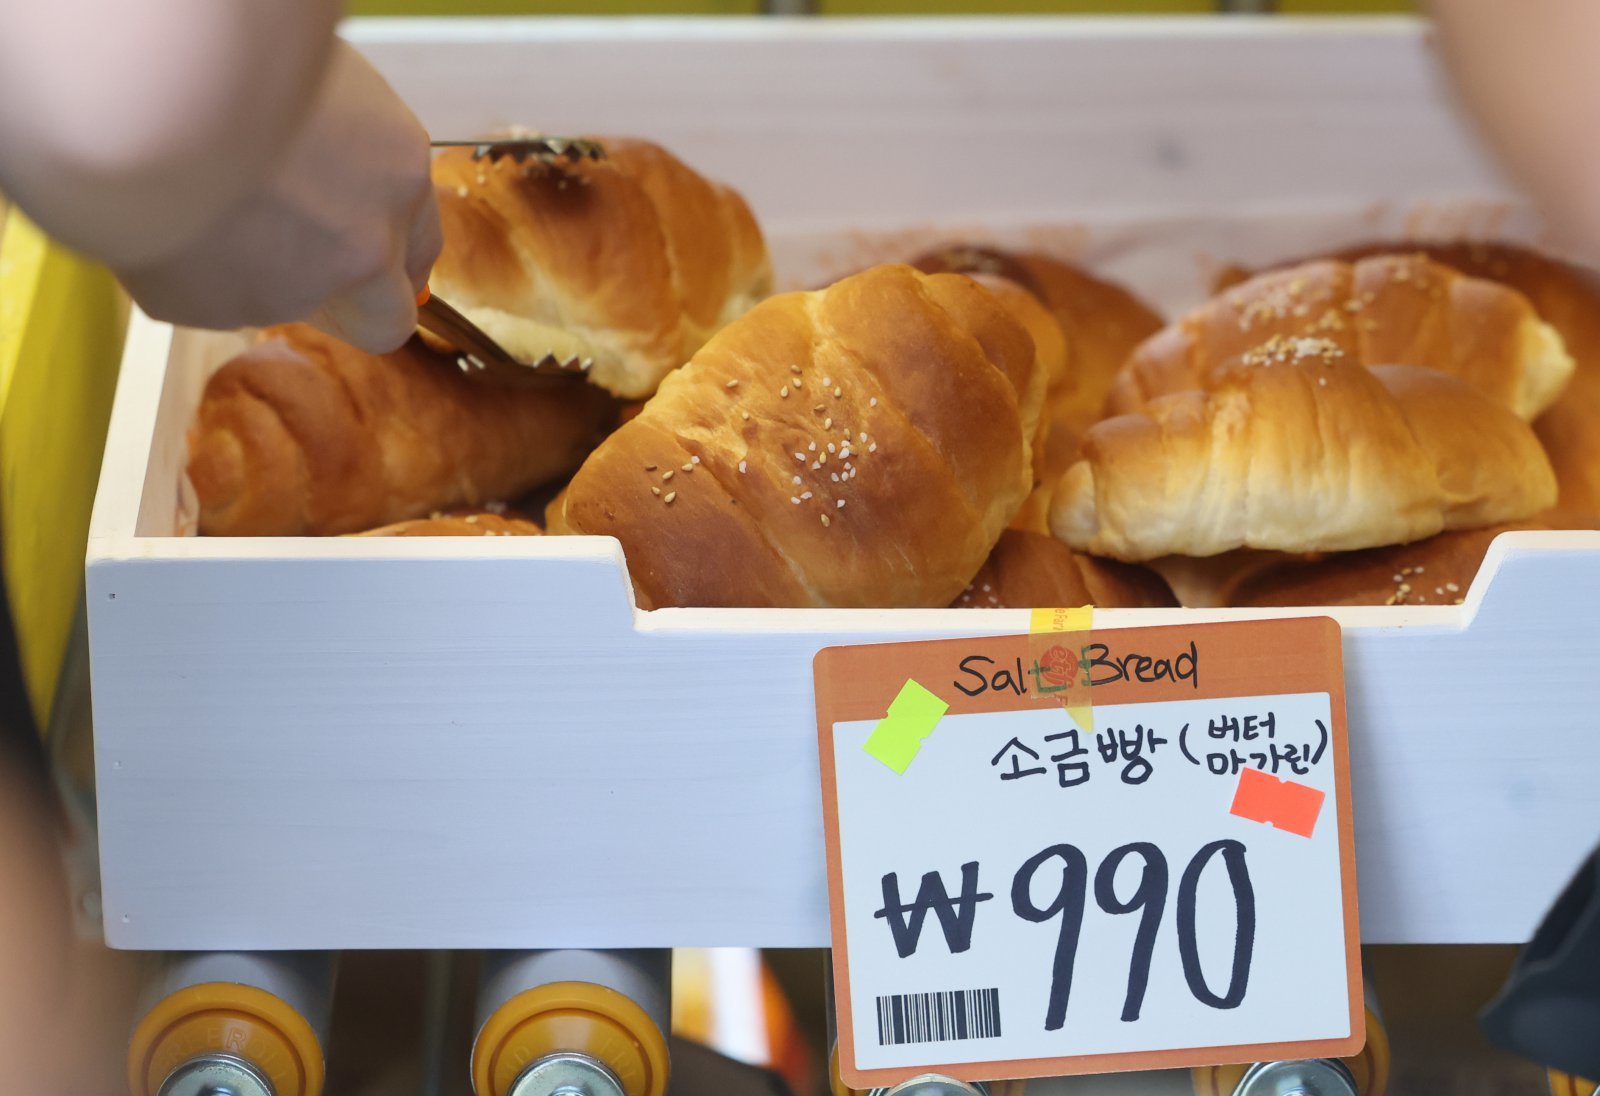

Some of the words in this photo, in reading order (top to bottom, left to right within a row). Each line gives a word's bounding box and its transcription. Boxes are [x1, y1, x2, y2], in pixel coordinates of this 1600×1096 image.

[953, 655, 1068, 697] Salt
[1079, 642, 1198, 688] Bread
[990, 723, 1168, 788] 소금빵
